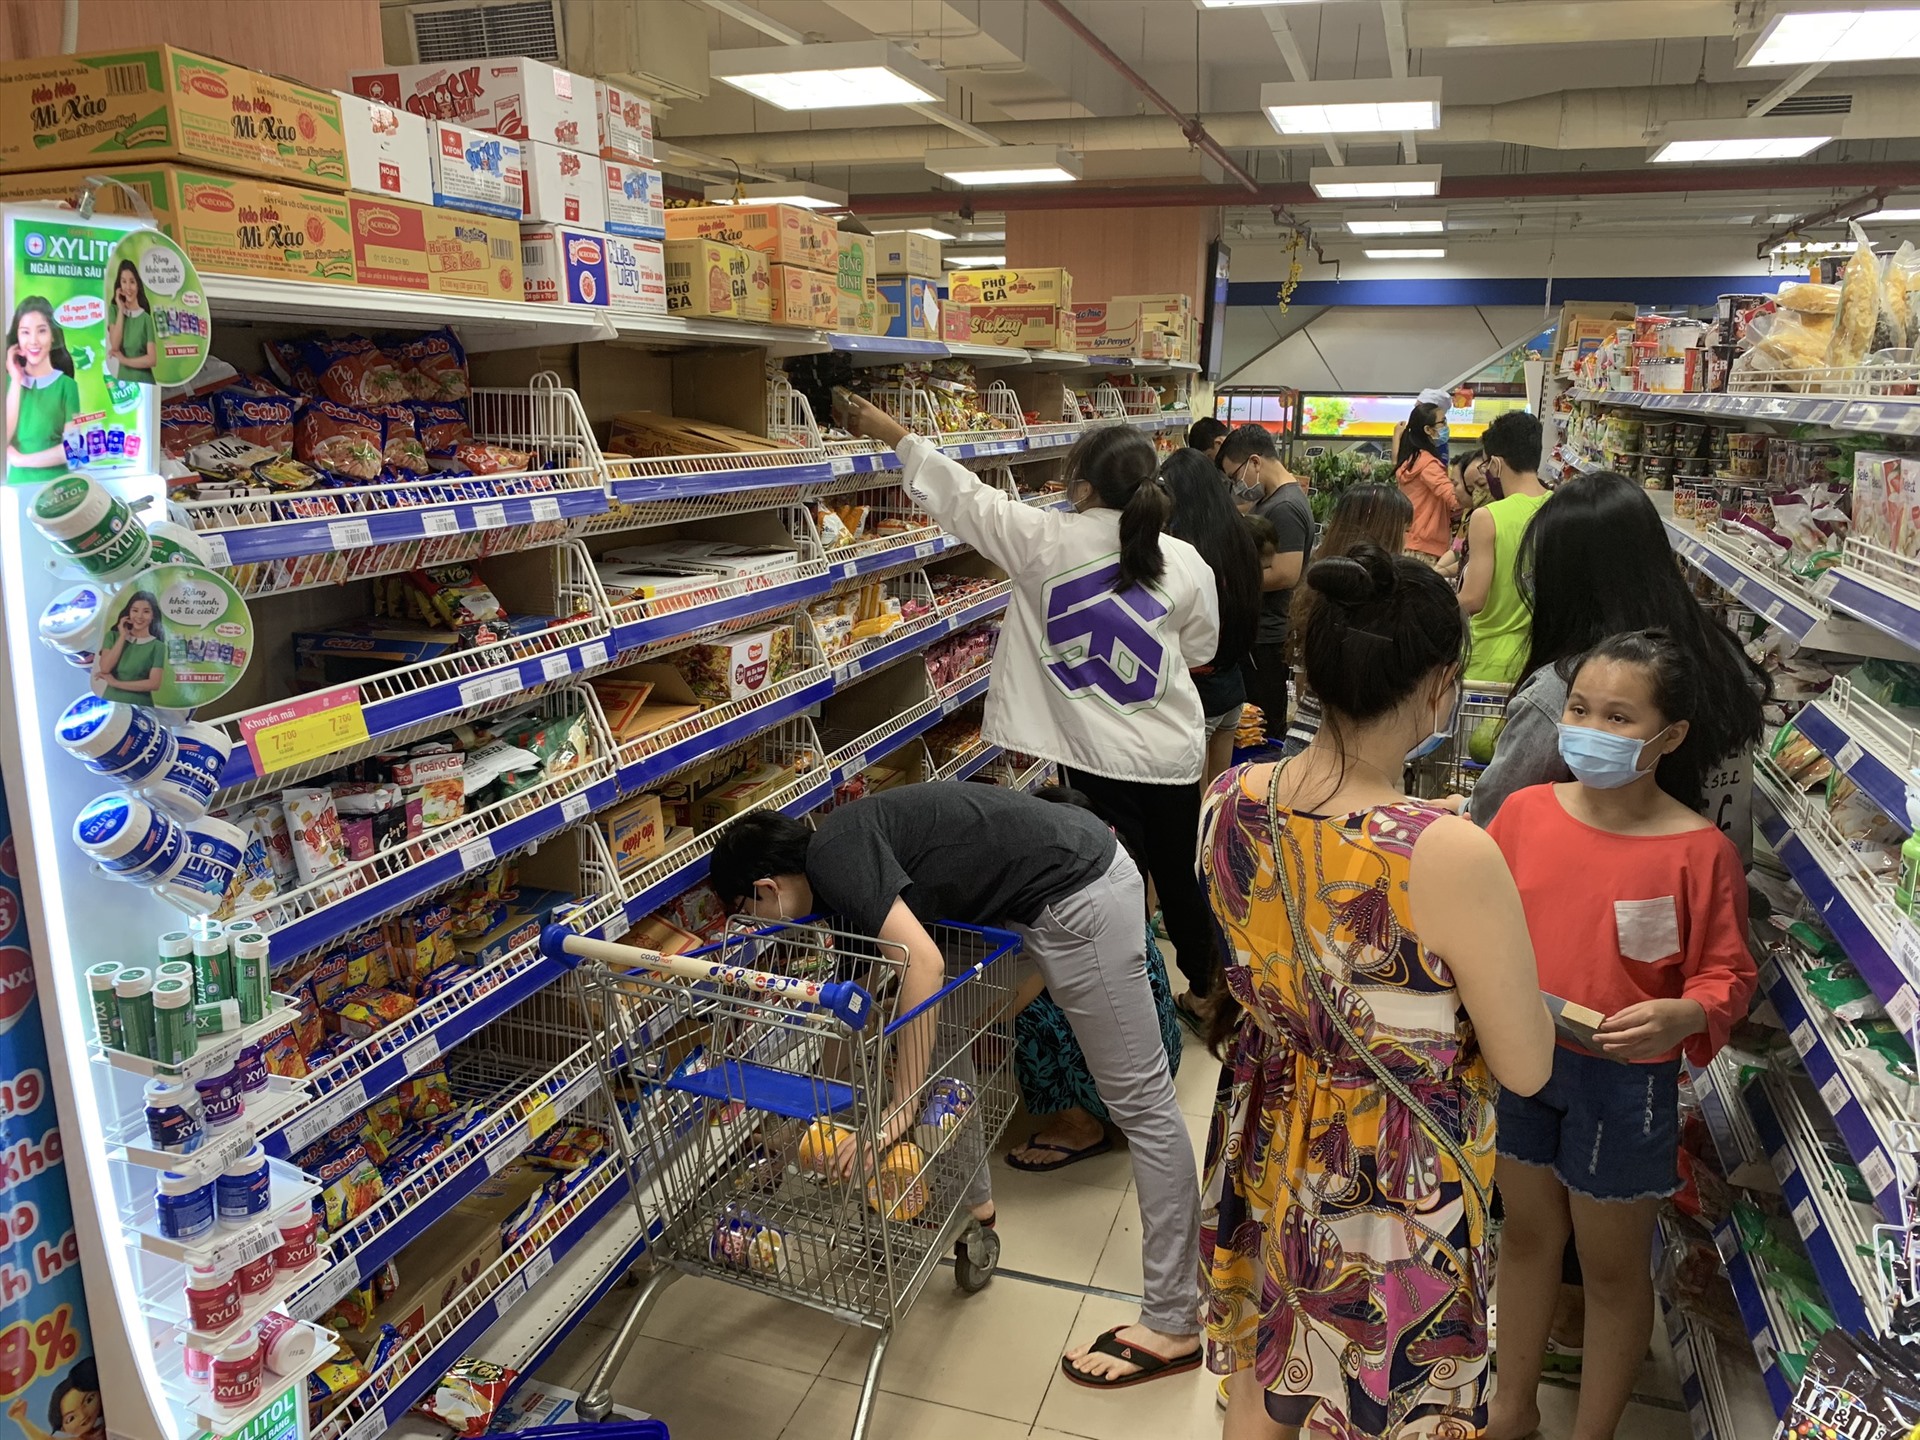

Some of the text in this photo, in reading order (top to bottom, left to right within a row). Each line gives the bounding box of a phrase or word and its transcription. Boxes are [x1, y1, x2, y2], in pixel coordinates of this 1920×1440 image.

[32, 77, 77, 105] Hảo Hảo
[192, 80, 227, 95] ACECOOK
[232, 94, 272, 114] Hảo Hảo
[31, 103, 60, 131] Mì
[231, 115, 257, 139] Mì
[198, 196, 233, 209] ACECOOK
[238, 205, 280, 224] Hảo Hảo
[369, 220, 399, 232] ACECOOK
[237, 225, 264, 250] Mì
[729, 256, 745, 276] PHỞ
[536, 277, 556, 291] BÒ
[666, 281, 690, 296] PHỞ
[731, 274, 748, 298] GÀ
[982, 275, 1006, 289] PHỞ
[667, 293, 692, 309] GÀ
[984, 287, 1007, 302] GÀ
[182, 586, 207, 600] Răng
[245, 707, 296, 731] Khuyến mãi
[329, 713, 352, 732] 7 700
[272, 730, 297, 750] 7 700
[186, 751, 204, 760] LOTTE
[416, 758, 446, 775] Hoàng
